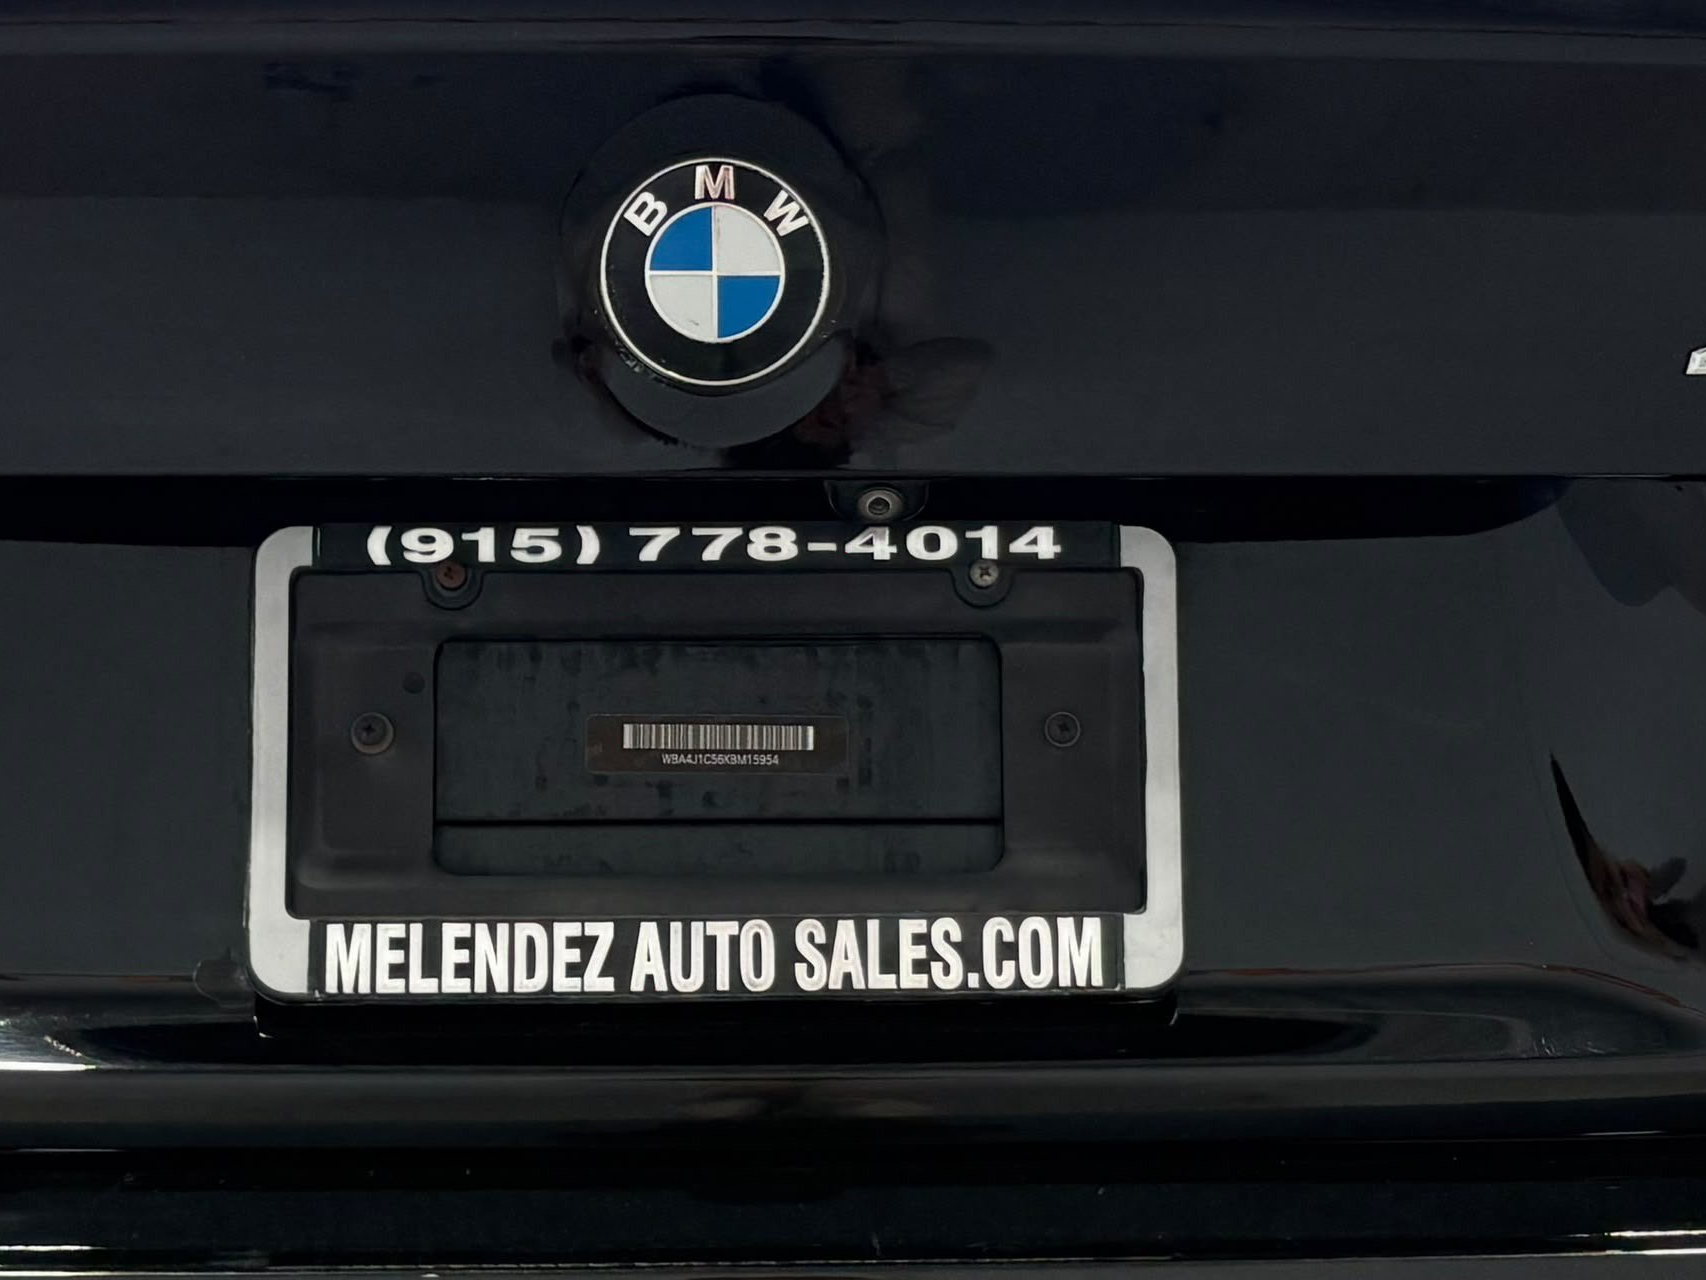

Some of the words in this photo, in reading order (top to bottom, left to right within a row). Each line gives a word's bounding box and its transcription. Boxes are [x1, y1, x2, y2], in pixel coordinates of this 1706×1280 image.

[624, 165, 809, 236] BMW
[366, 525, 601, 565] (915)
[629, 525, 1062, 562] 778-4014
[324, 921, 615, 994] MELENDEZ
[629, 919, 776, 993] AUTO
[794, 916, 1104, 994] SALES.COM
